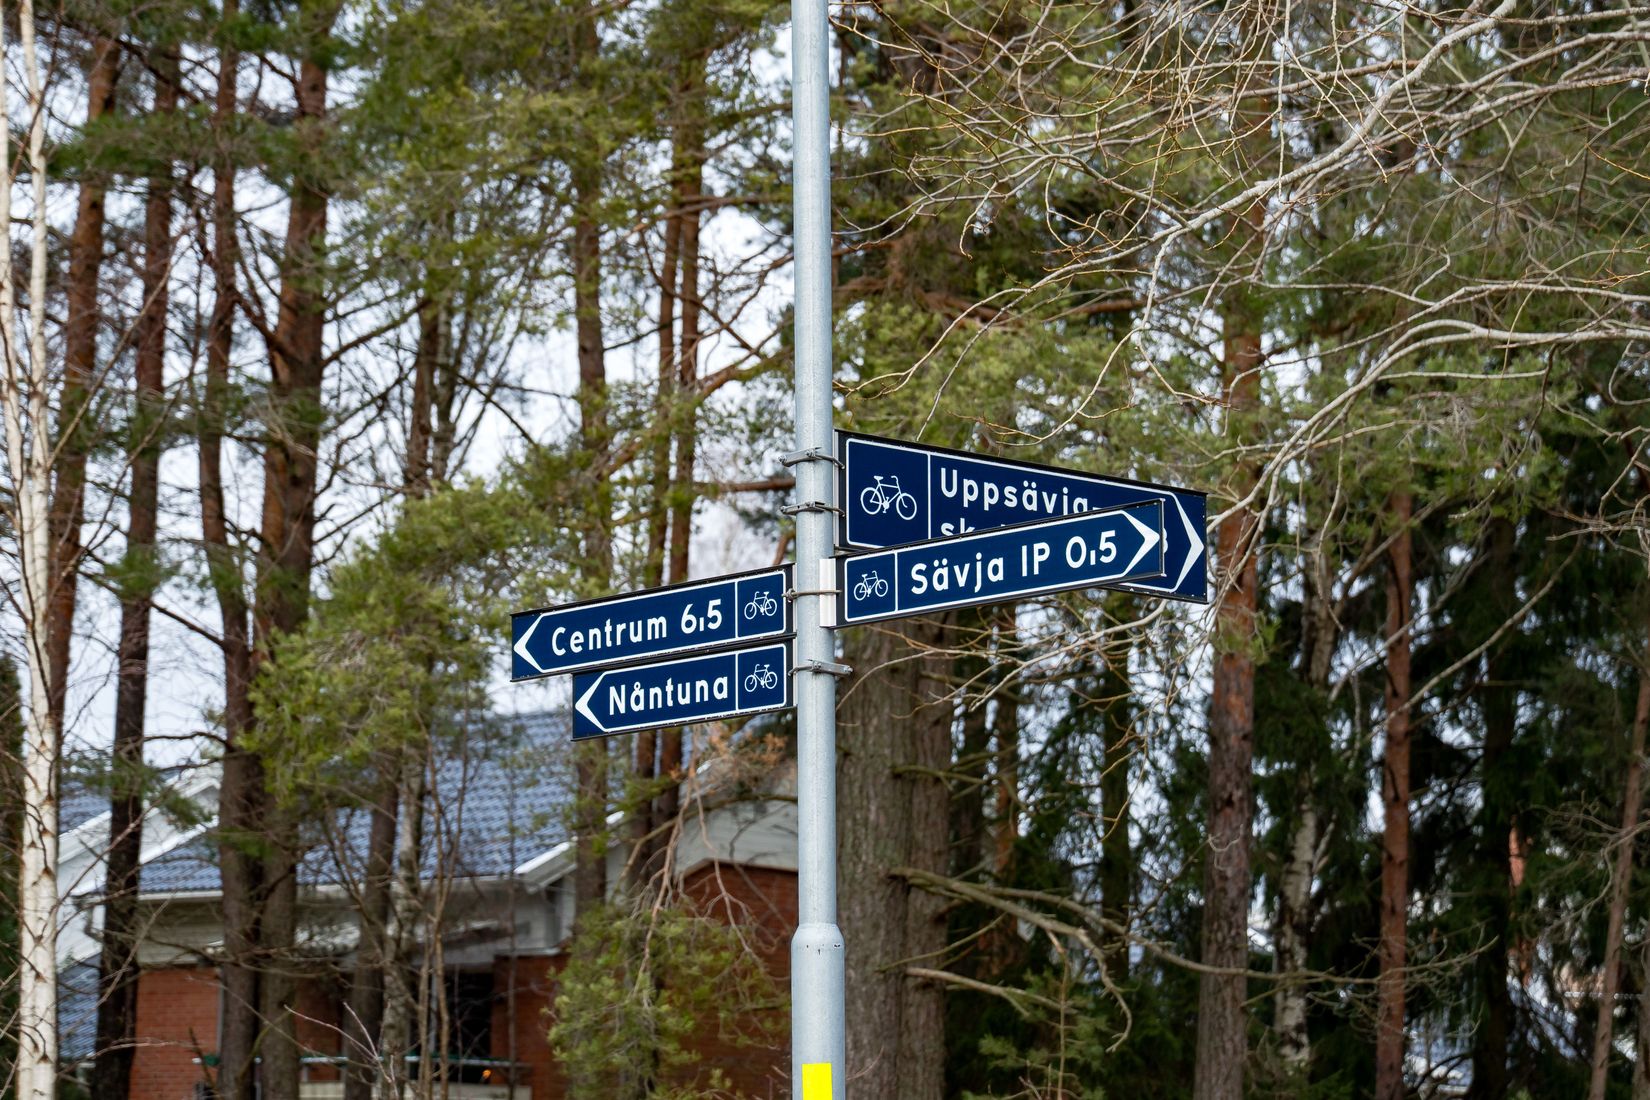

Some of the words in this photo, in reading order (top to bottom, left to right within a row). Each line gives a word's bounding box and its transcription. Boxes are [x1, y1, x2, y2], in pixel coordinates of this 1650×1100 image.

[910, 552, 1004, 595] Sävja
[1021, 541, 1051, 577] IP
[1065, 529, 1117, 569] 0,5
[551, 615, 667, 656] Centrum
[680, 598, 723, 634] 6,5
[609, 676, 728, 716] Nåntuna
